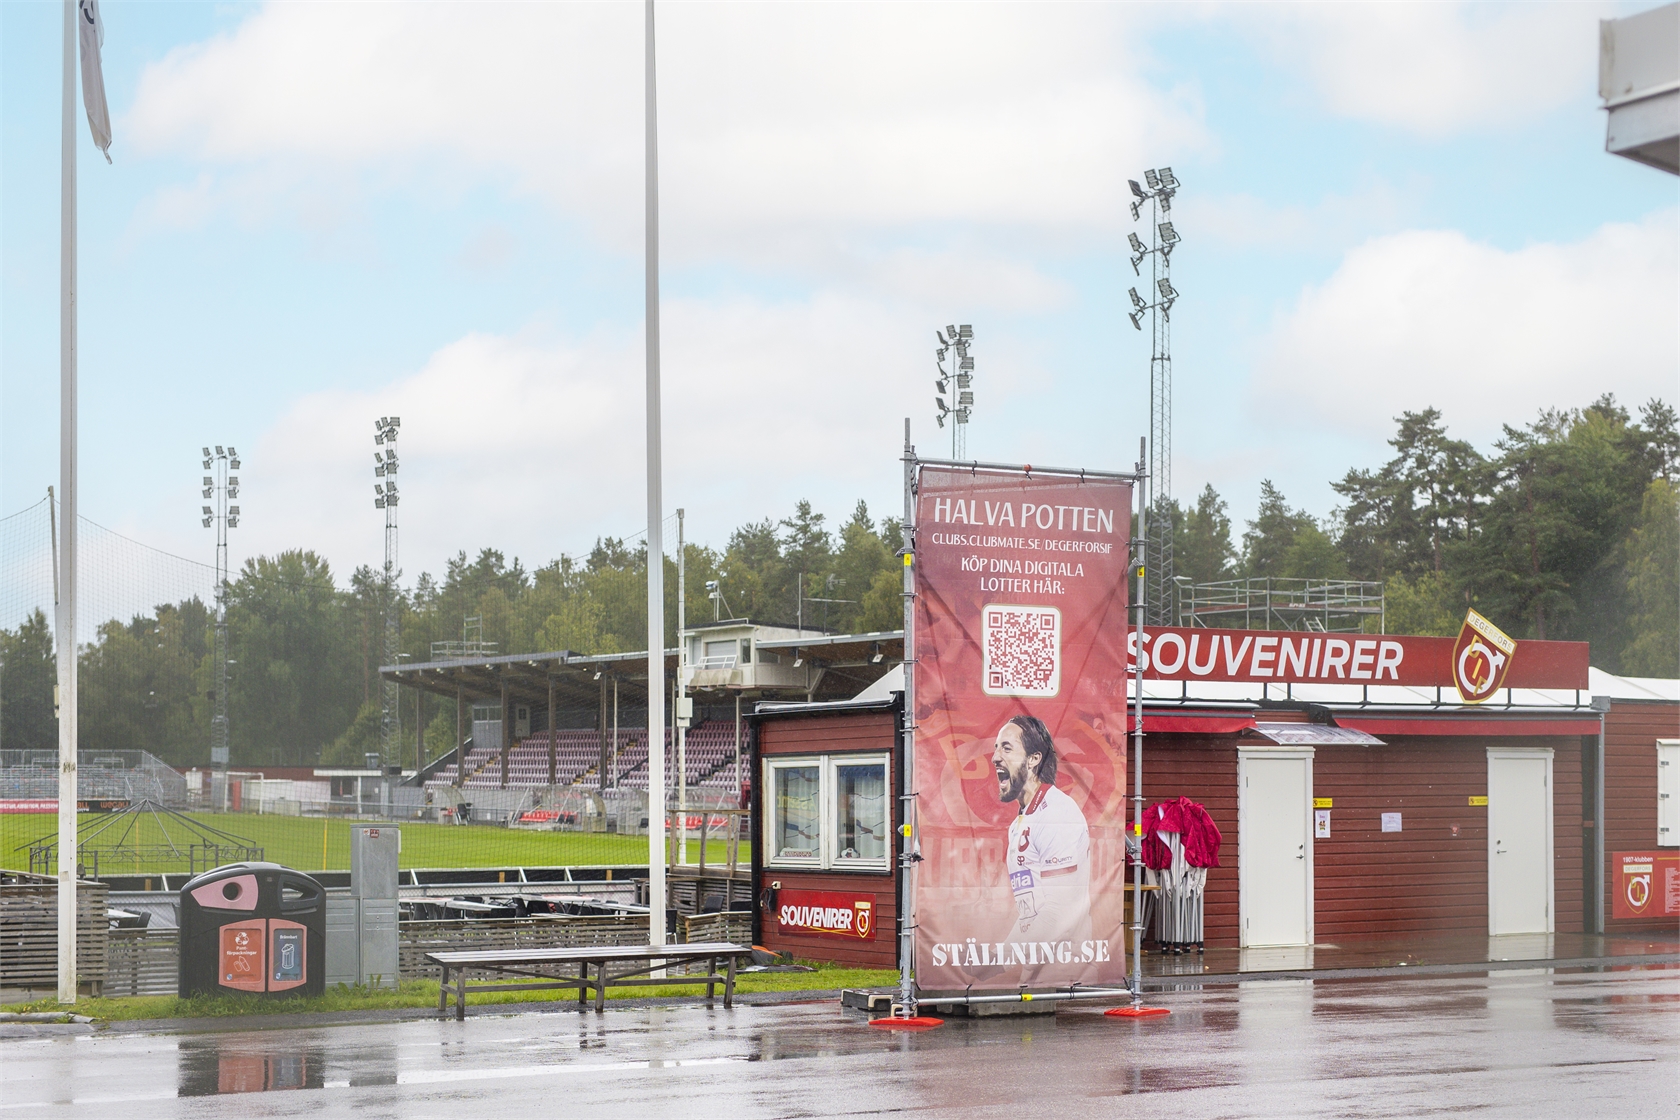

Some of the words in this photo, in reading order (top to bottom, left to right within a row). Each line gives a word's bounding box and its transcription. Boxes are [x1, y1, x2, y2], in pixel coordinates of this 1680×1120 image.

[934, 497, 1015, 527] HALVA
[1020, 503, 1114, 533] POTTEN
[932, 533, 1113, 554] CLUBS.CLUBMATE.SE/DEGERFORSIF
[961, 555, 988, 572] KÖP
[990, 559, 1022, 574] DINA
[1024, 561, 1084, 577] DIGITALA
[980, 577, 1031, 593] LOTTER
[1033, 577, 1065, 594] HÄR:
[1469, 614, 1512, 651] DEGERFORS
[1127, 631, 1404, 680] SOUVENIRER
[780, 904, 853, 930] SOUVENIRER
[932, 938, 1111, 967] STÄLLNING.SE
